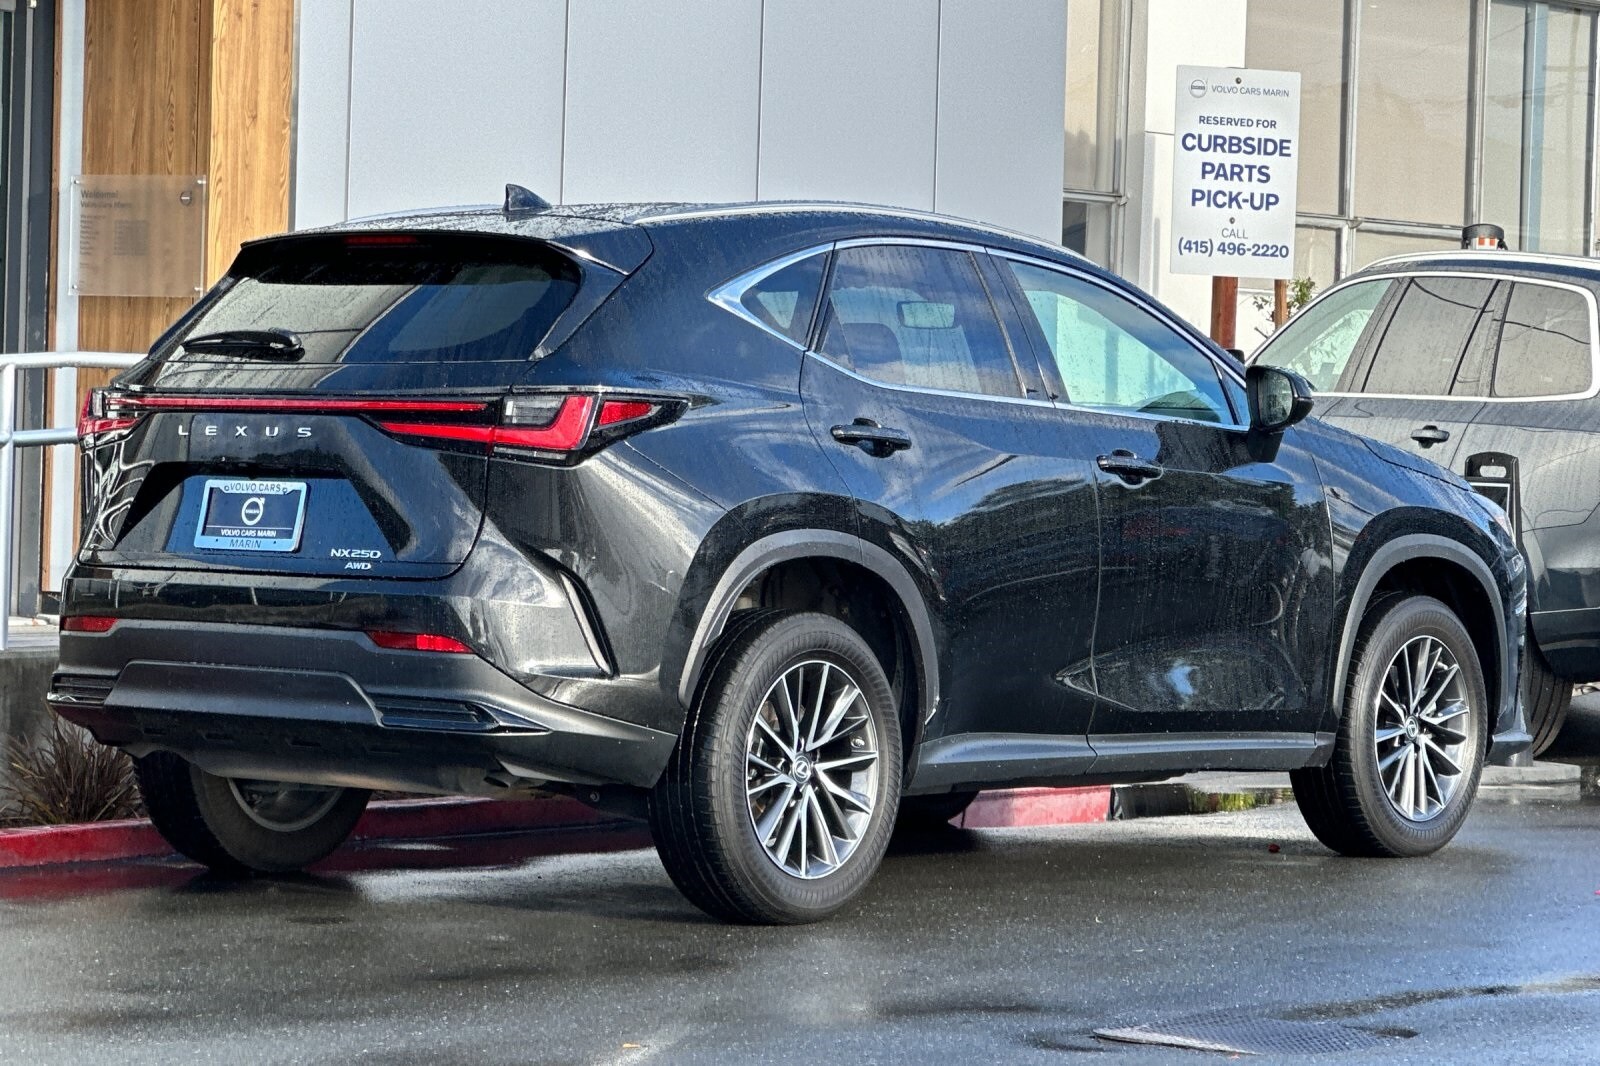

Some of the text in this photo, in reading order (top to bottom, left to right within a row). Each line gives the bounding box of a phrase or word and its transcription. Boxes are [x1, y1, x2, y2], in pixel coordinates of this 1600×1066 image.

[1211, 85, 1239, 95] VOLVO
[1239, 86, 1262, 96] CARS
[1262, 88, 1290, 98] MARIN
[1199, 115, 1277, 129] RESERVED FOR
[1181, 133, 1292, 157] CURBSIDE
[1201, 162, 1271, 183] PARTS
[1191, 188, 1280, 211] PICK-UP
[1221, 227, 1249, 239] CALL
[1178, 237, 1289, 258] (415) 496-2220
[177, 425, 312, 437] LEXUS
[230, 483, 281, 493] VOLVO CARS
[240, 529, 257, 537] CARS
[257, 529, 277, 537] MARIN
[229, 539, 262, 549] MARIN
[330, 548, 382, 559] NX250
[344, 562, 372, 570] AWD
